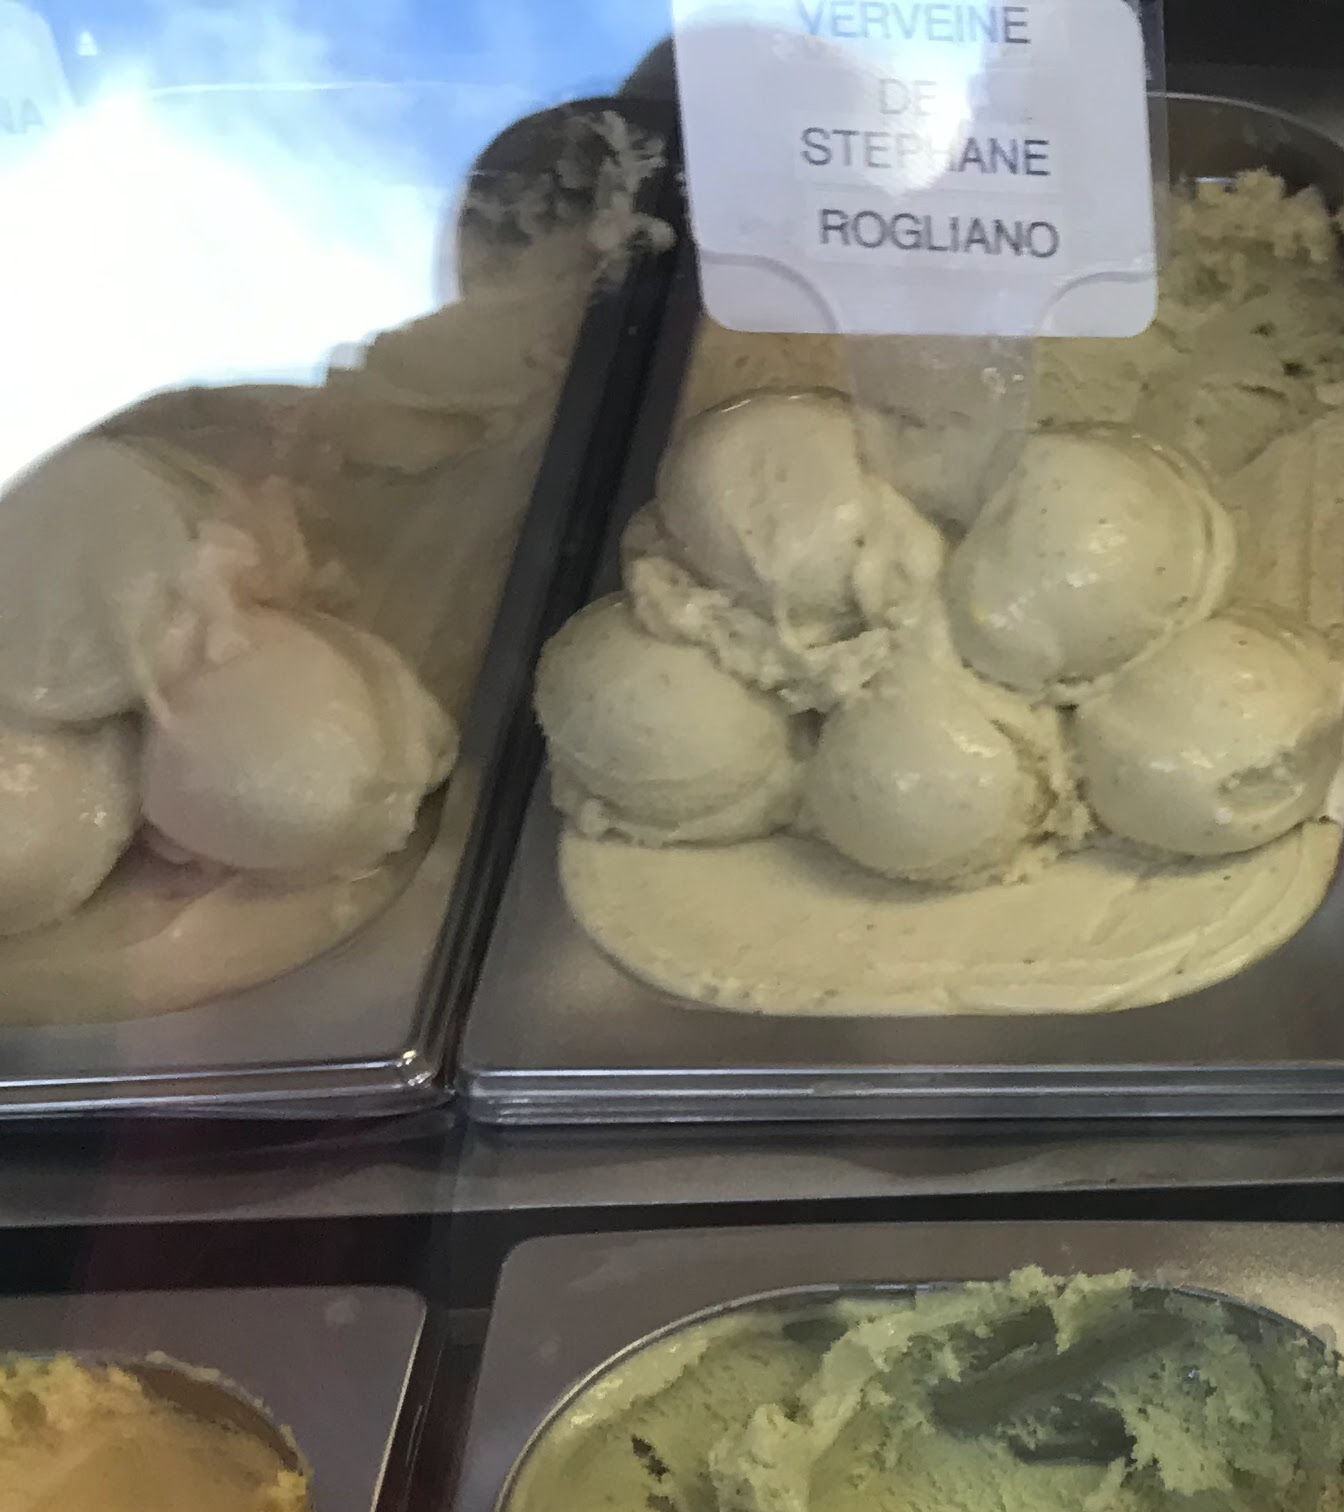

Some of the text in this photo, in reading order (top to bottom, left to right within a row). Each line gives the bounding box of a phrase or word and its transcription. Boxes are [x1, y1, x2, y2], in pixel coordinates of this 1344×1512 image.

[800, 0, 1031, 44] VERVEINE
[877, 77, 940, 116] DE
[801, 127, 1052, 177] STEPANE
[818, 208, 1060, 259] ROGLIANO
